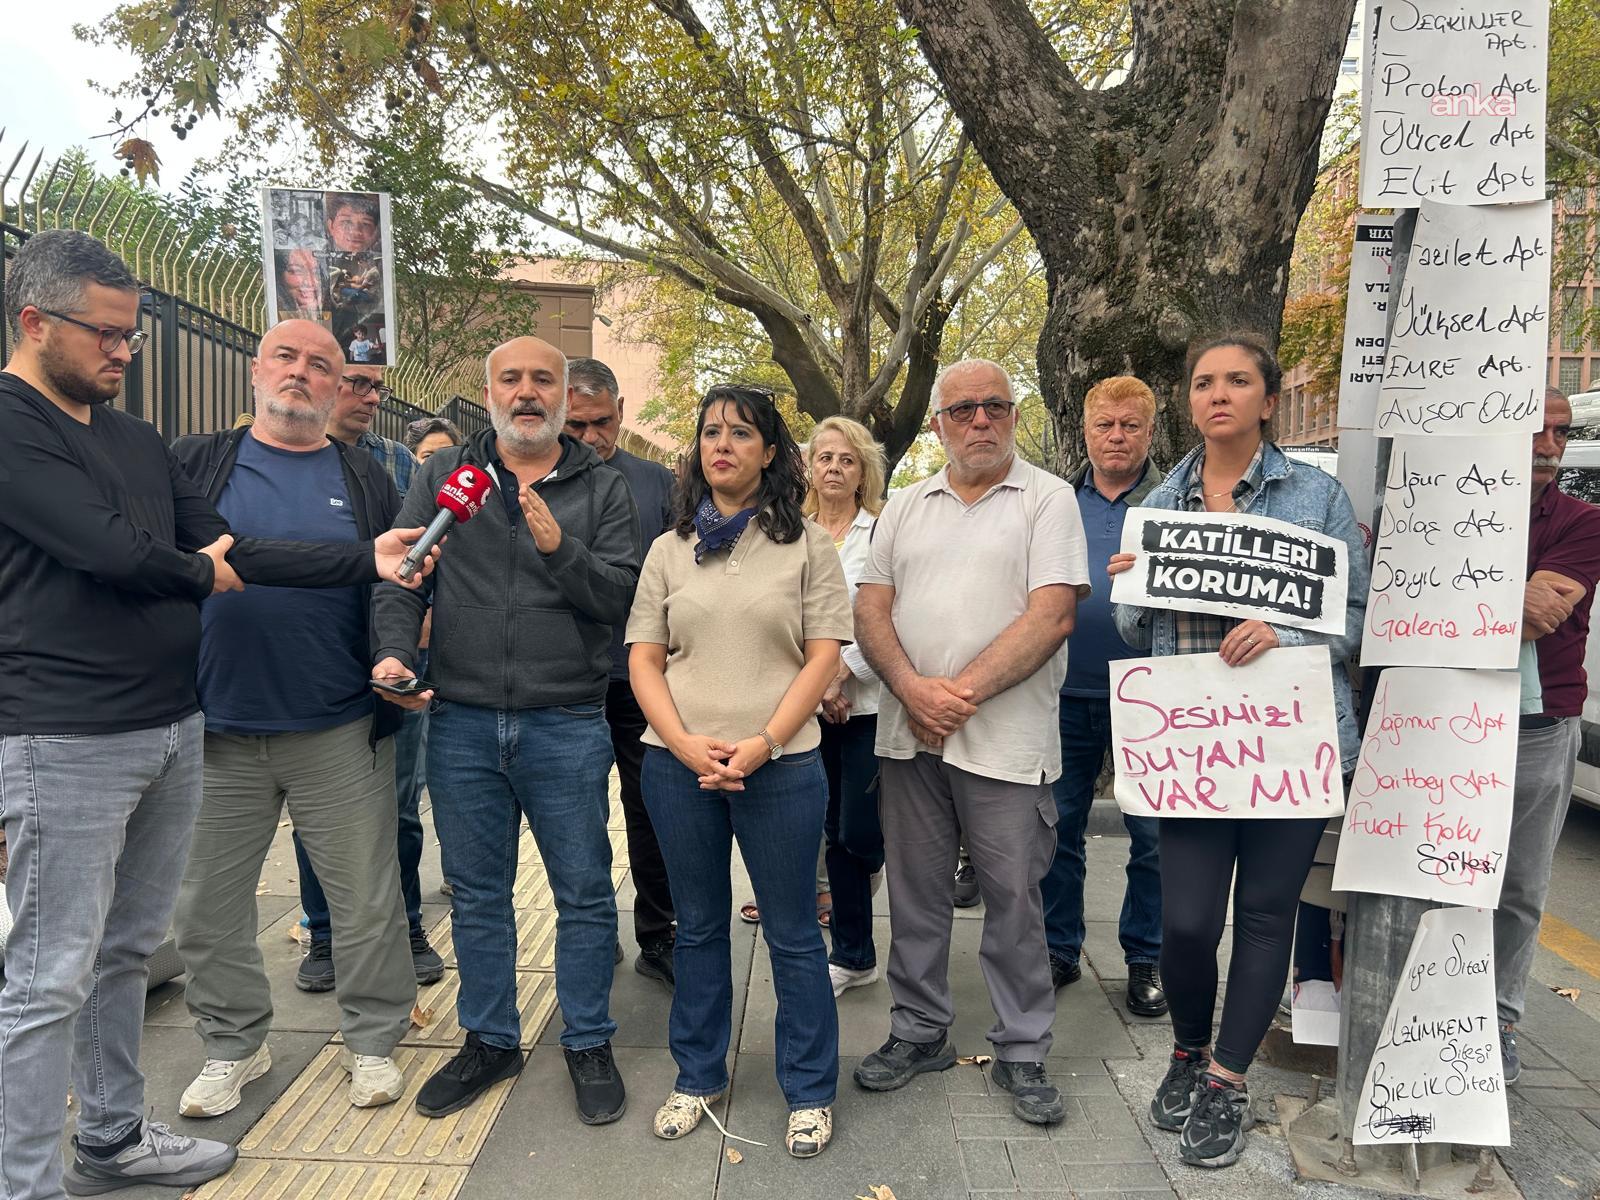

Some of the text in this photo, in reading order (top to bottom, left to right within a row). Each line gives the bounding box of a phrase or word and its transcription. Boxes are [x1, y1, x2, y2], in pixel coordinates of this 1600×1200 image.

[1485, 33, 1537, 57] Apt.
[1382, 63, 1478, 98] Proton
[1380, 117, 1535, 155] Yücel Apt
[1378, 162, 1535, 196] Elit Apt
[1393, 286, 1546, 340] Yüksel Apt
[1355, 337, 1384, 347] DEN
[1349, 372, 1383, 383] LARI
[1386, 355, 1531, 379] EMRE Apt.
[443, 483, 469, 503] anka
[1457, 464, 1521, 496] Apt.
[1454, 509, 1513, 538] Apt.
[1158, 527, 1318, 570] KATİLLERİ
[1152, 565, 1312, 610] KORUMA!
[1452, 558, 1513, 590] Apt.
[1371, 593, 1460, 642] Galeria
[1449, 702, 1507, 743] Apt
[1121, 736, 1265, 778] DUYAN
[1138, 776, 1230, 812] VAR
[1449, 769, 1513, 799] Apt
[1444, 1060, 1500, 1096] Sitesi
